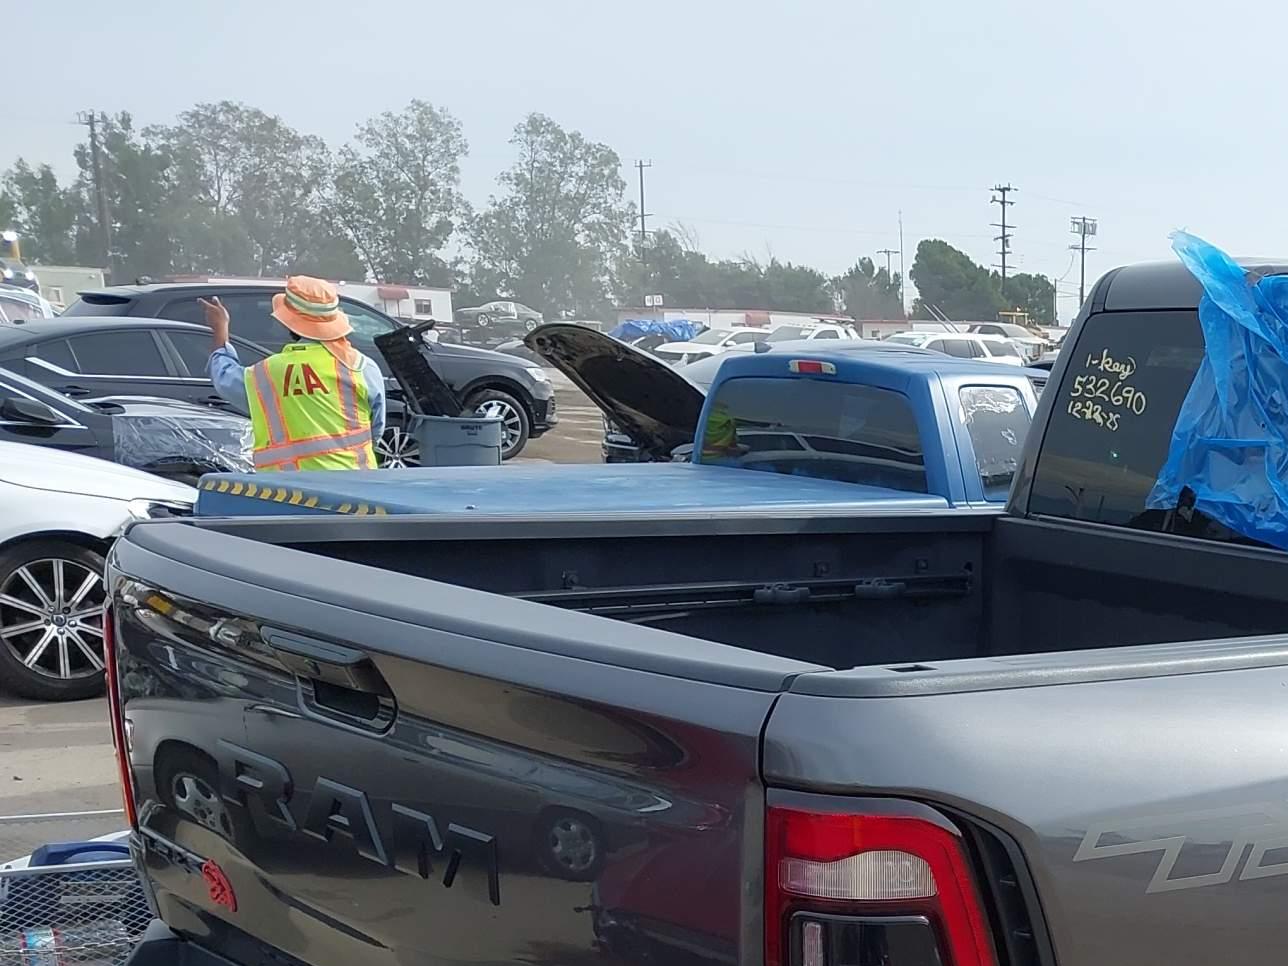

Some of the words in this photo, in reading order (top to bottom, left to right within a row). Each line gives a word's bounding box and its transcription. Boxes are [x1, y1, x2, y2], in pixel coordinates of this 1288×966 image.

[283, 363, 330, 397] IAA
[1070, 376, 1146, 415] 532690
[216, 738, 500, 906] RAM
